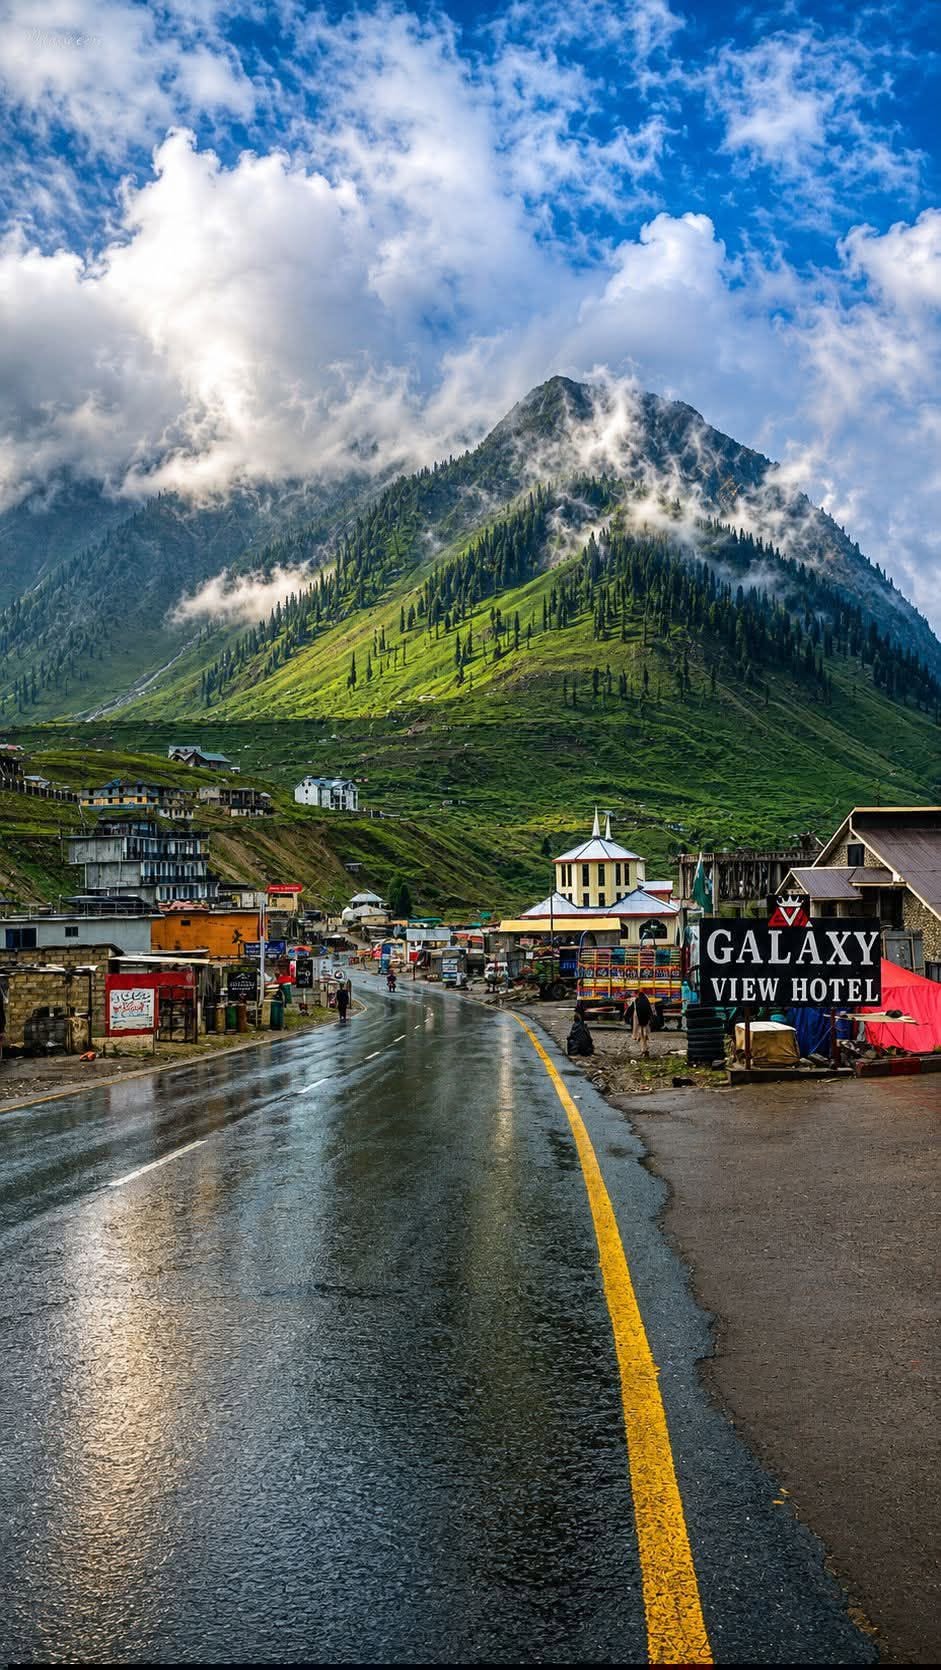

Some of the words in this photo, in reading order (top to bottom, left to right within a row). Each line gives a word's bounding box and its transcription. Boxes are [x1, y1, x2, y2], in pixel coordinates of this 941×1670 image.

[706, 928, 879, 966] GALAXY
[710, 977, 780, 1002] VIEW
[791, 977, 879, 1002] HOTEL
